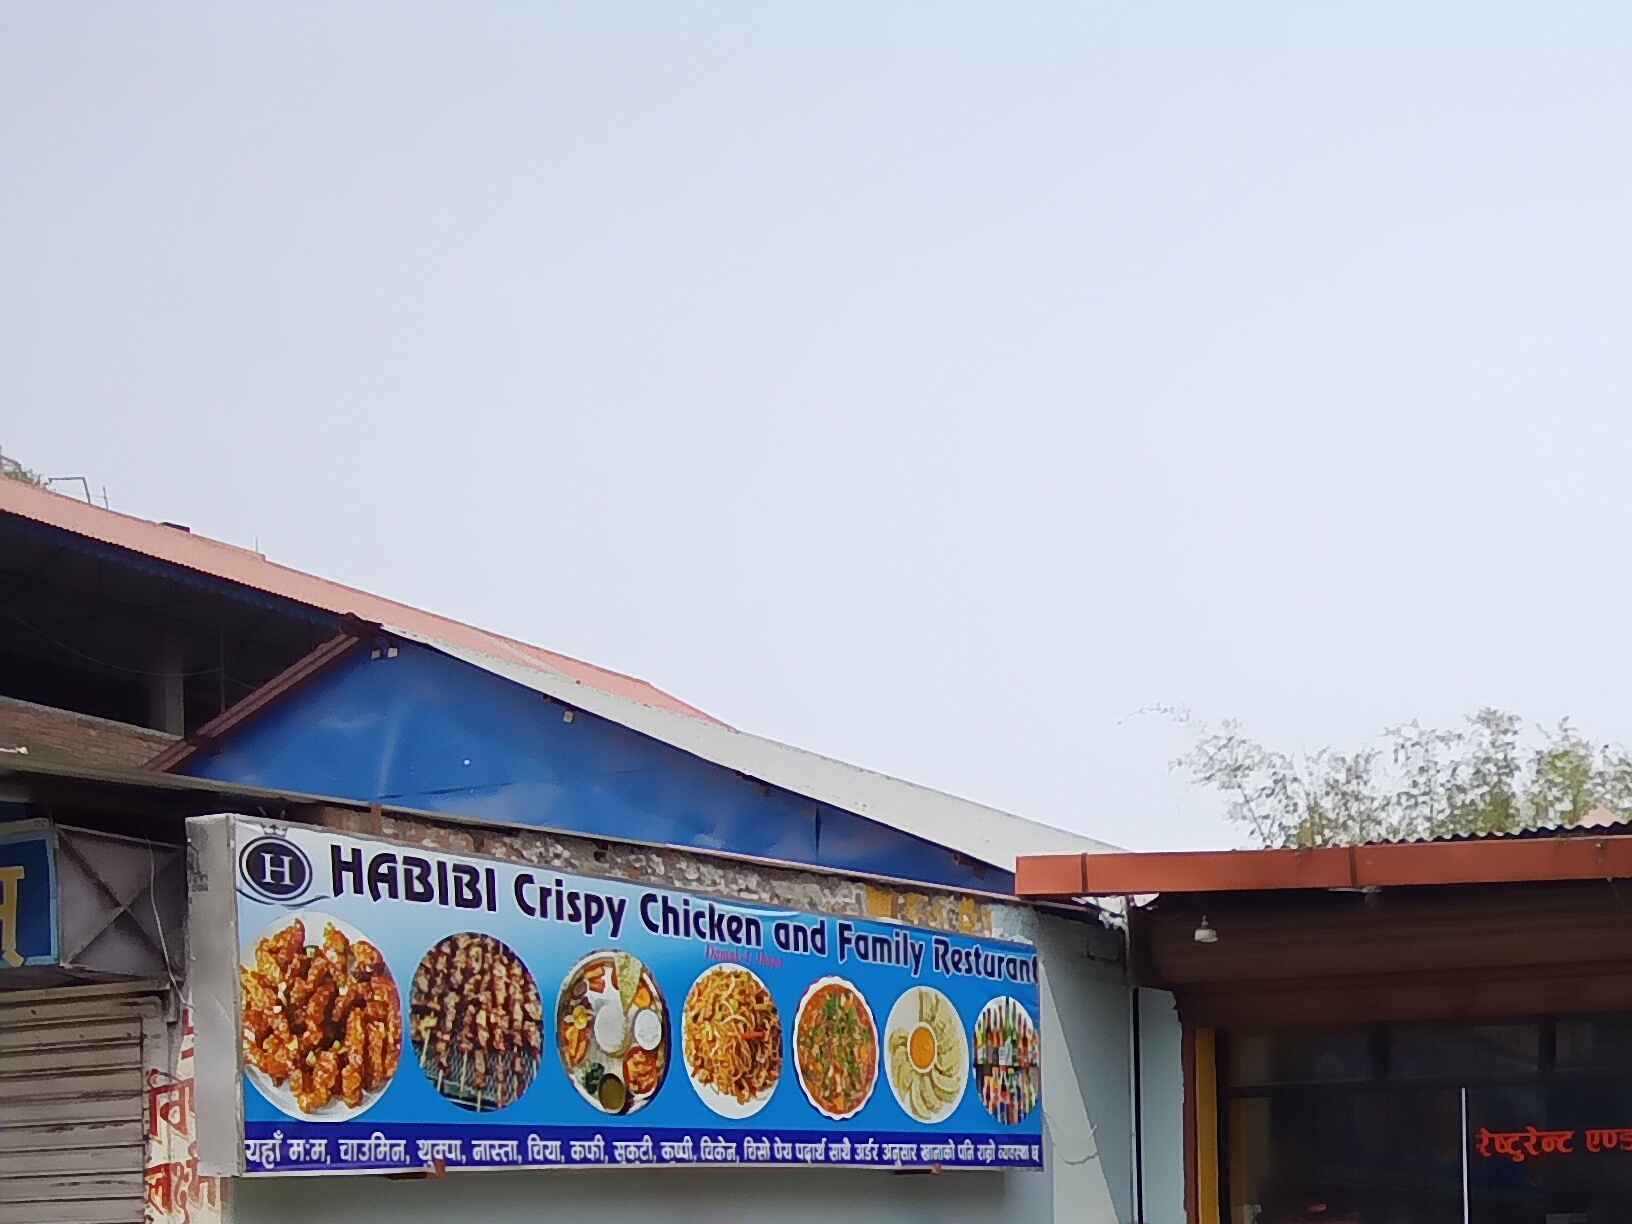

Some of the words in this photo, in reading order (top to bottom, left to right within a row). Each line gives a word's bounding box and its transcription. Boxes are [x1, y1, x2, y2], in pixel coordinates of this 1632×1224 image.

[260, 852, 295, 887] H
[329, 843, 497, 913] HABIBI
[514, 872, 627, 938] Crispy
[639, 892, 762, 947] Chicken
[774, 918, 827, 956] and
[838, 922, 924, 976] Family
[244, 1129, 284, 1170] यहाँ
[337, 1131, 411, 1165] चाउमिन,
[527, 1132, 565, 1164] चिया,
[569, 1133, 609, 1164] कफी,
